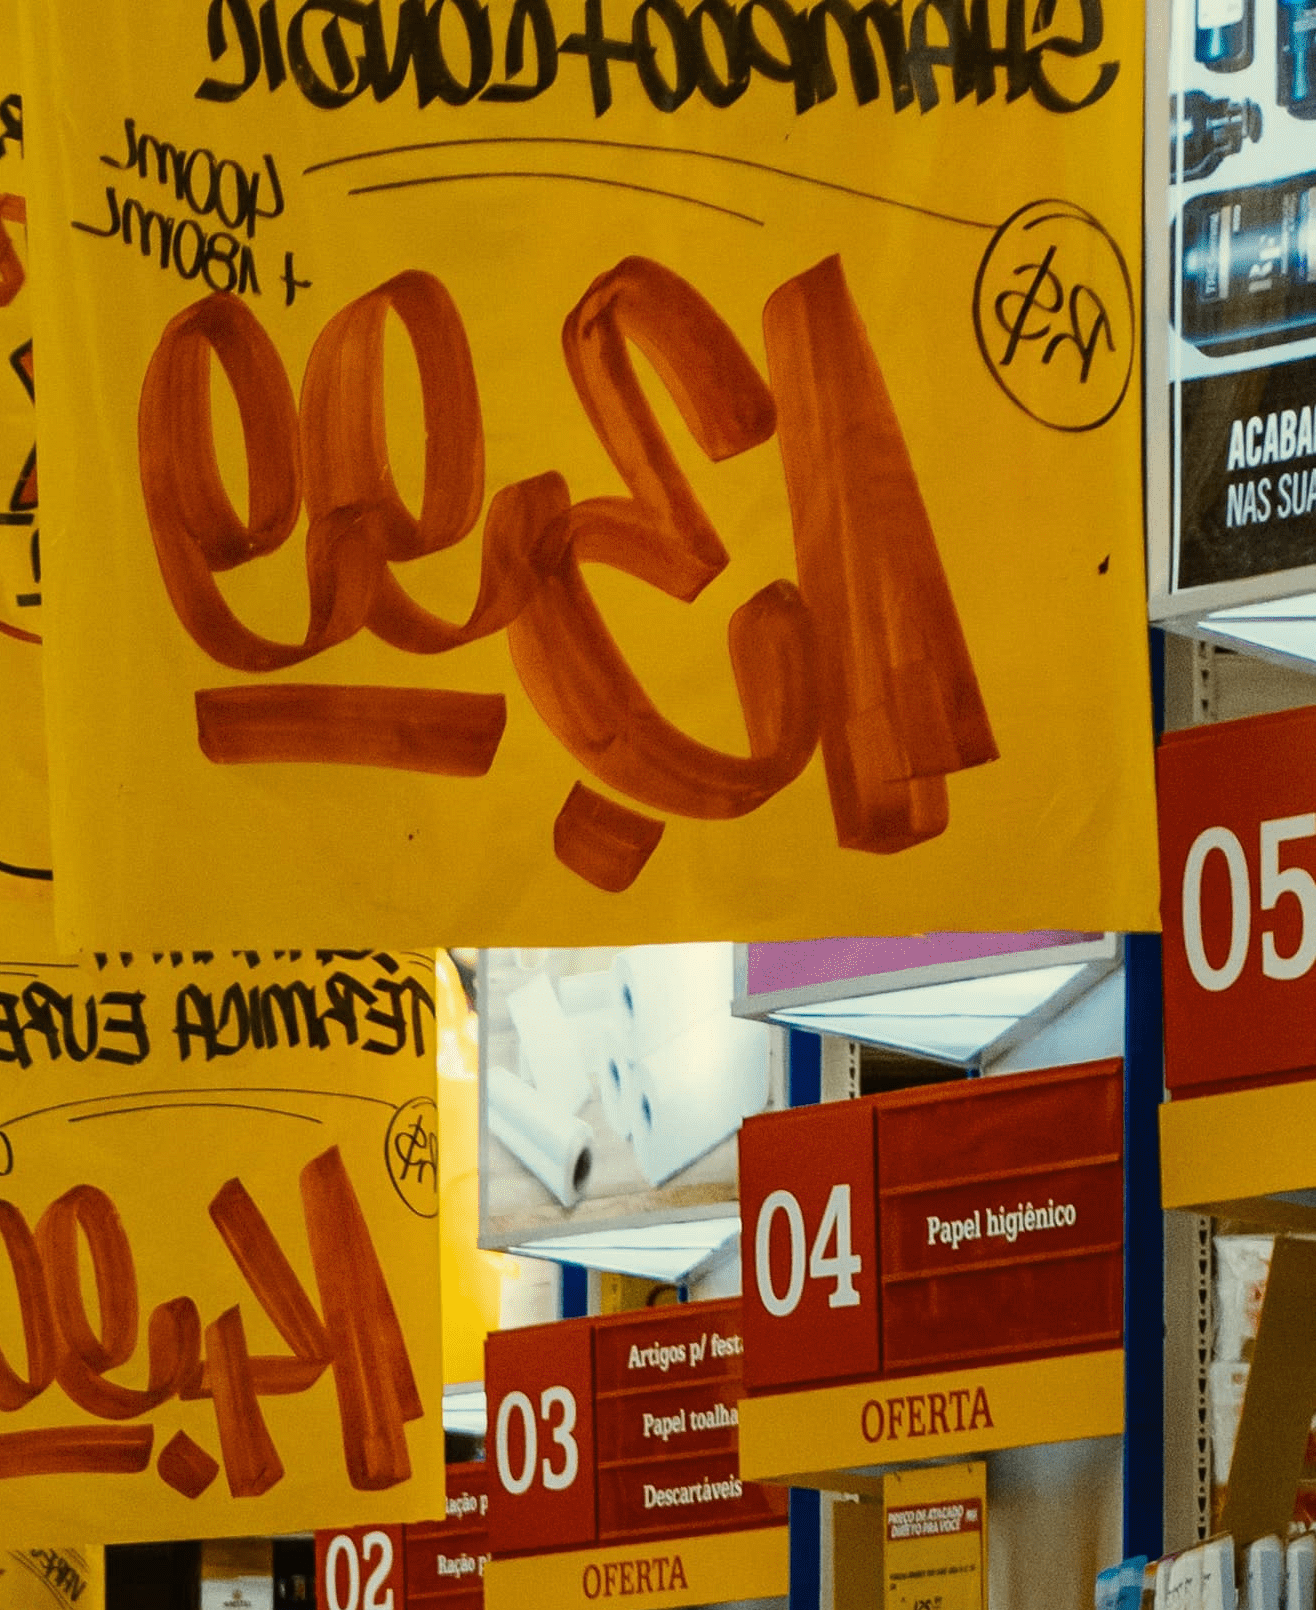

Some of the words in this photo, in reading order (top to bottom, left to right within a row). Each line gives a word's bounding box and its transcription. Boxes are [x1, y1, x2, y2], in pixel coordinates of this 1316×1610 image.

[1226, 479, 1270, 528] NAS
[1181, 814, 1316, 993] 05
[927, 1214, 980, 1249] Papel
[986, 1199, 1077, 1243] higiênico
[755, 1183, 862, 1318] 04
[628, 1339, 685, 1370] Artigos
[689, 1334, 707, 1366] p/
[642, 1413, 686, 1440] Papel
[689, 1405, 739, 1433] toalha
[861, 1386, 994, 1444] OFERTA
[495, 1387, 578, 1494] 03
[643, 1478, 743, 1509] Descartáveis
[437, 1553, 475, 1576] Ração
[583, 1555, 688, 1600] OFERTA
